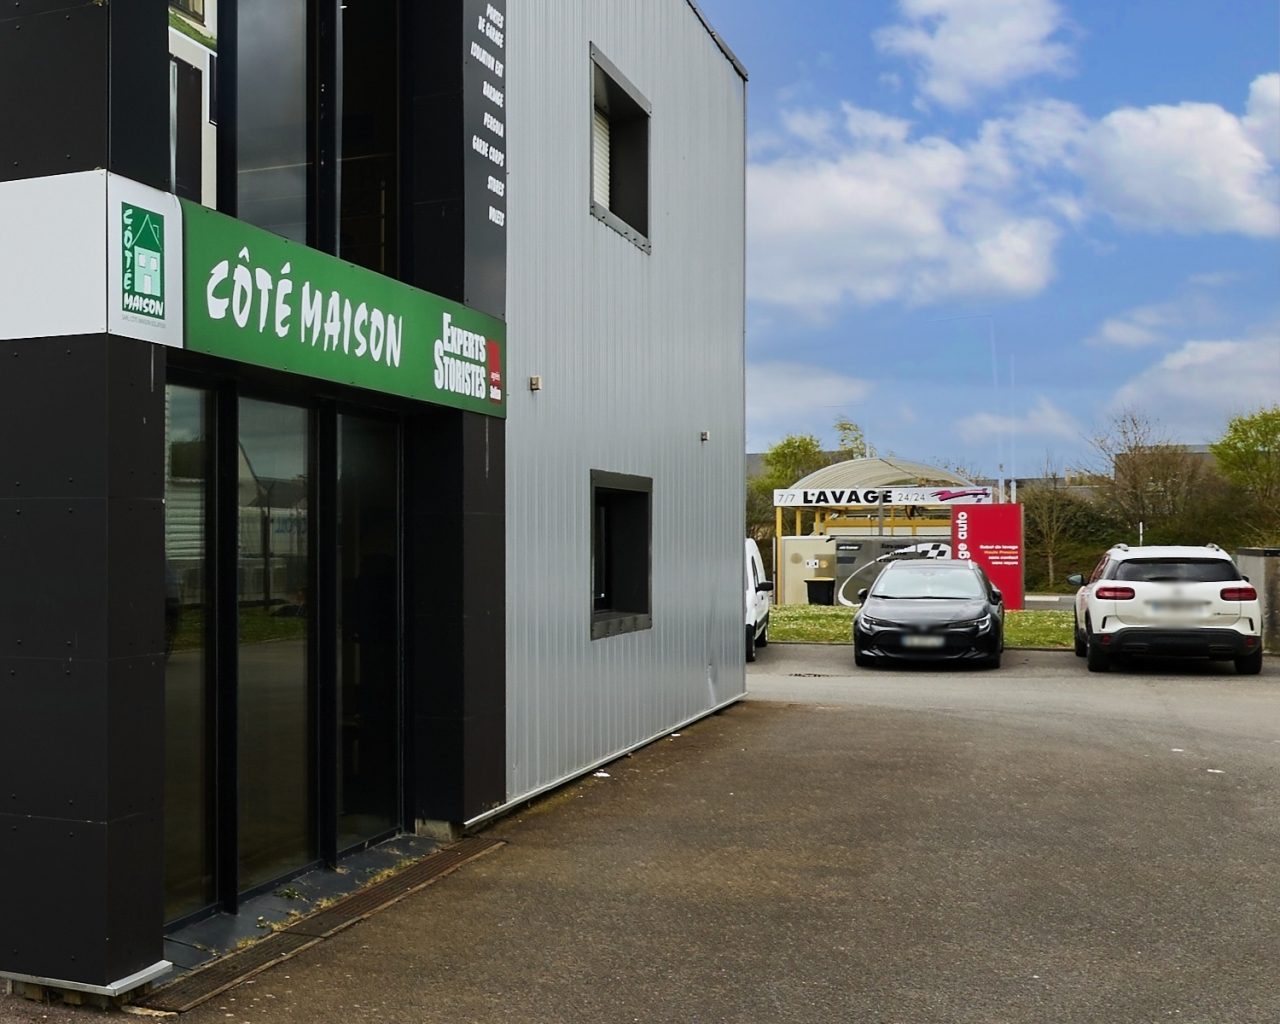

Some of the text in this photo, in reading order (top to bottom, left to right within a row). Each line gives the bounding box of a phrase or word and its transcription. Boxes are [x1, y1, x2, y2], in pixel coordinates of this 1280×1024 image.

[123, 208, 133, 290] CÔTÉ
[123, 292, 164, 316] MAISON
[206, 246, 403, 368] CÔTÉ MAISON
[443, 312, 486, 363] EXPERTS
[434, 339, 486, 399] STORISTES
[778, 494, 796, 503] 7/7
[897, 492, 926, 503] 24/24
[955, 511, 968, 540] auto
